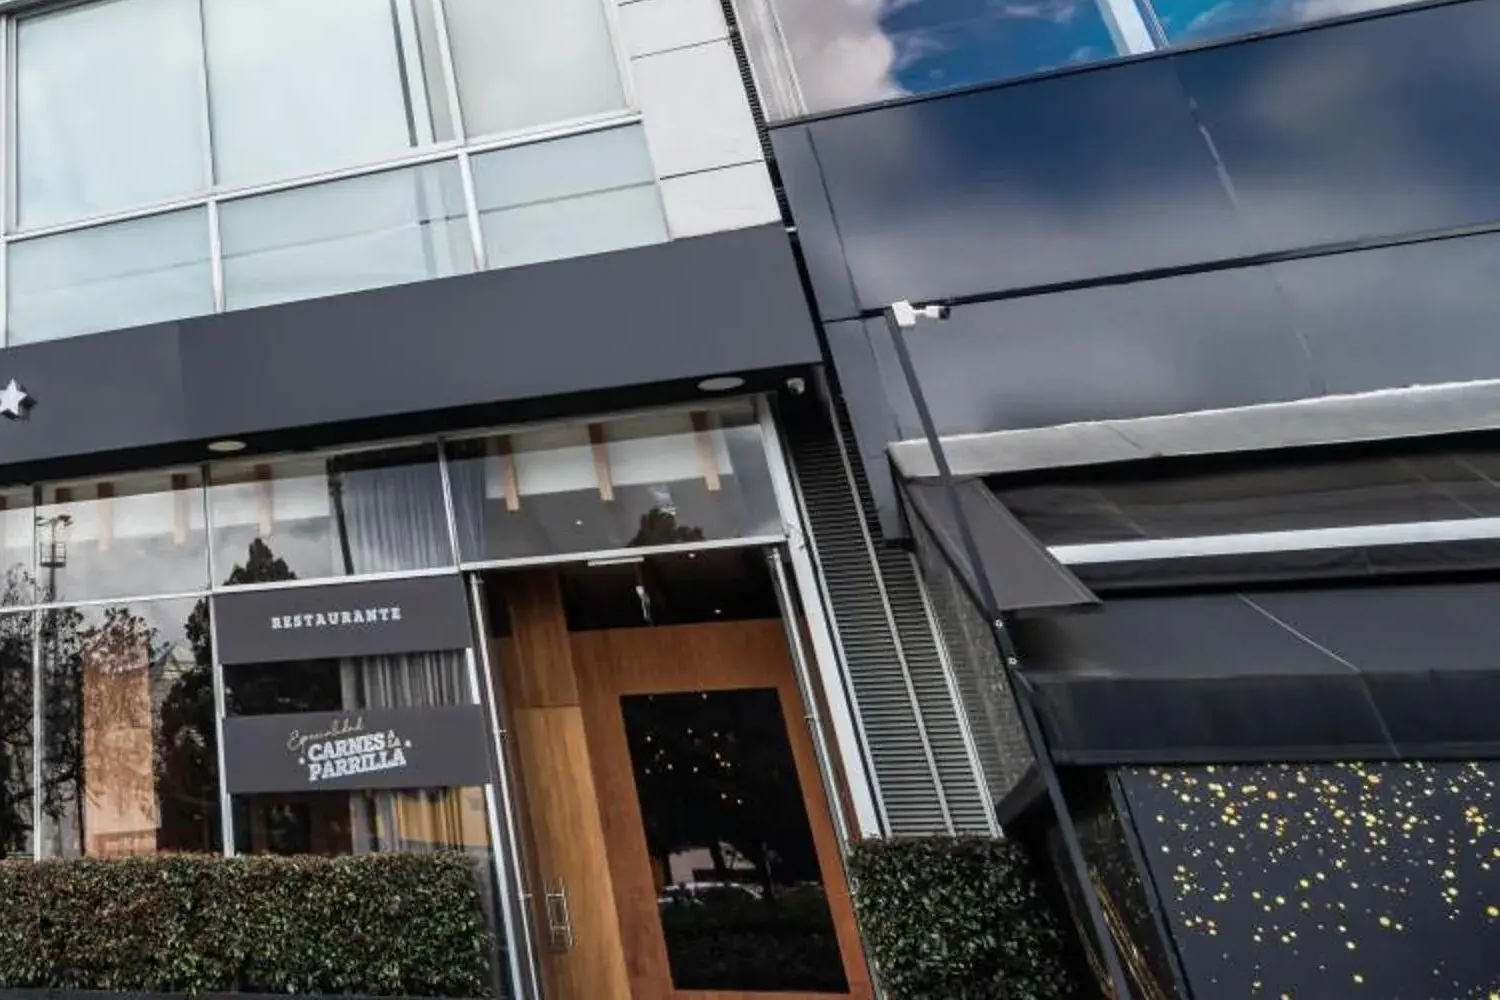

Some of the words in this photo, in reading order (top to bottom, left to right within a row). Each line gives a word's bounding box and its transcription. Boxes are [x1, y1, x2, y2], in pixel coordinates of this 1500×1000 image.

[271, 607, 401, 629] RESTAURANTE
[308, 732, 385, 762] CARNES
[308, 748, 407, 783] PARRILLA
